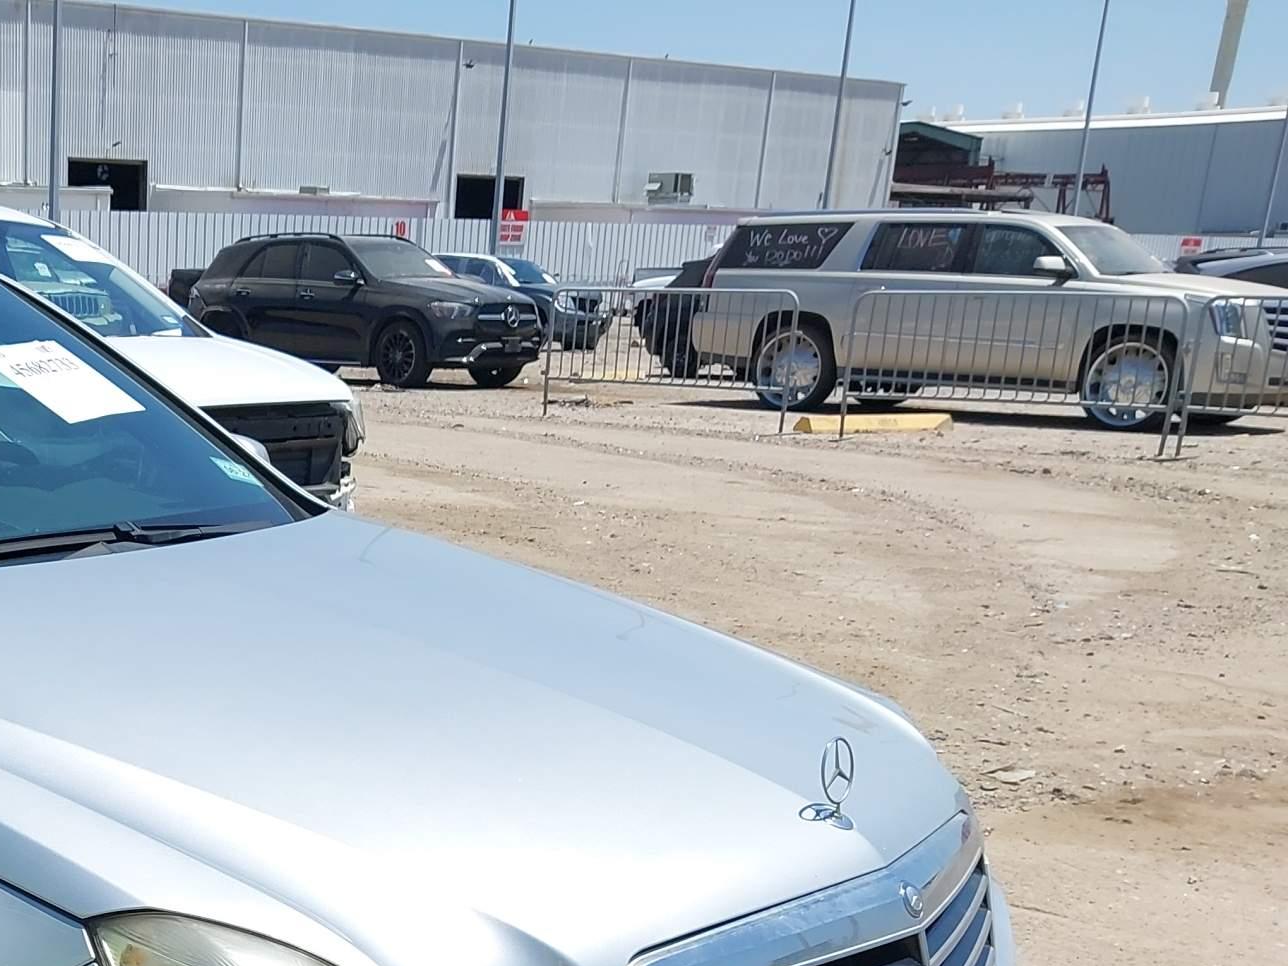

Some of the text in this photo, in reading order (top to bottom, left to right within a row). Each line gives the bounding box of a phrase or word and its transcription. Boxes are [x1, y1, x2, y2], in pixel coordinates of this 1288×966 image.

[395, 221, 406, 237] 10
[778, 228, 809, 245] Love
[896, 227, 948, 249] LOVE
